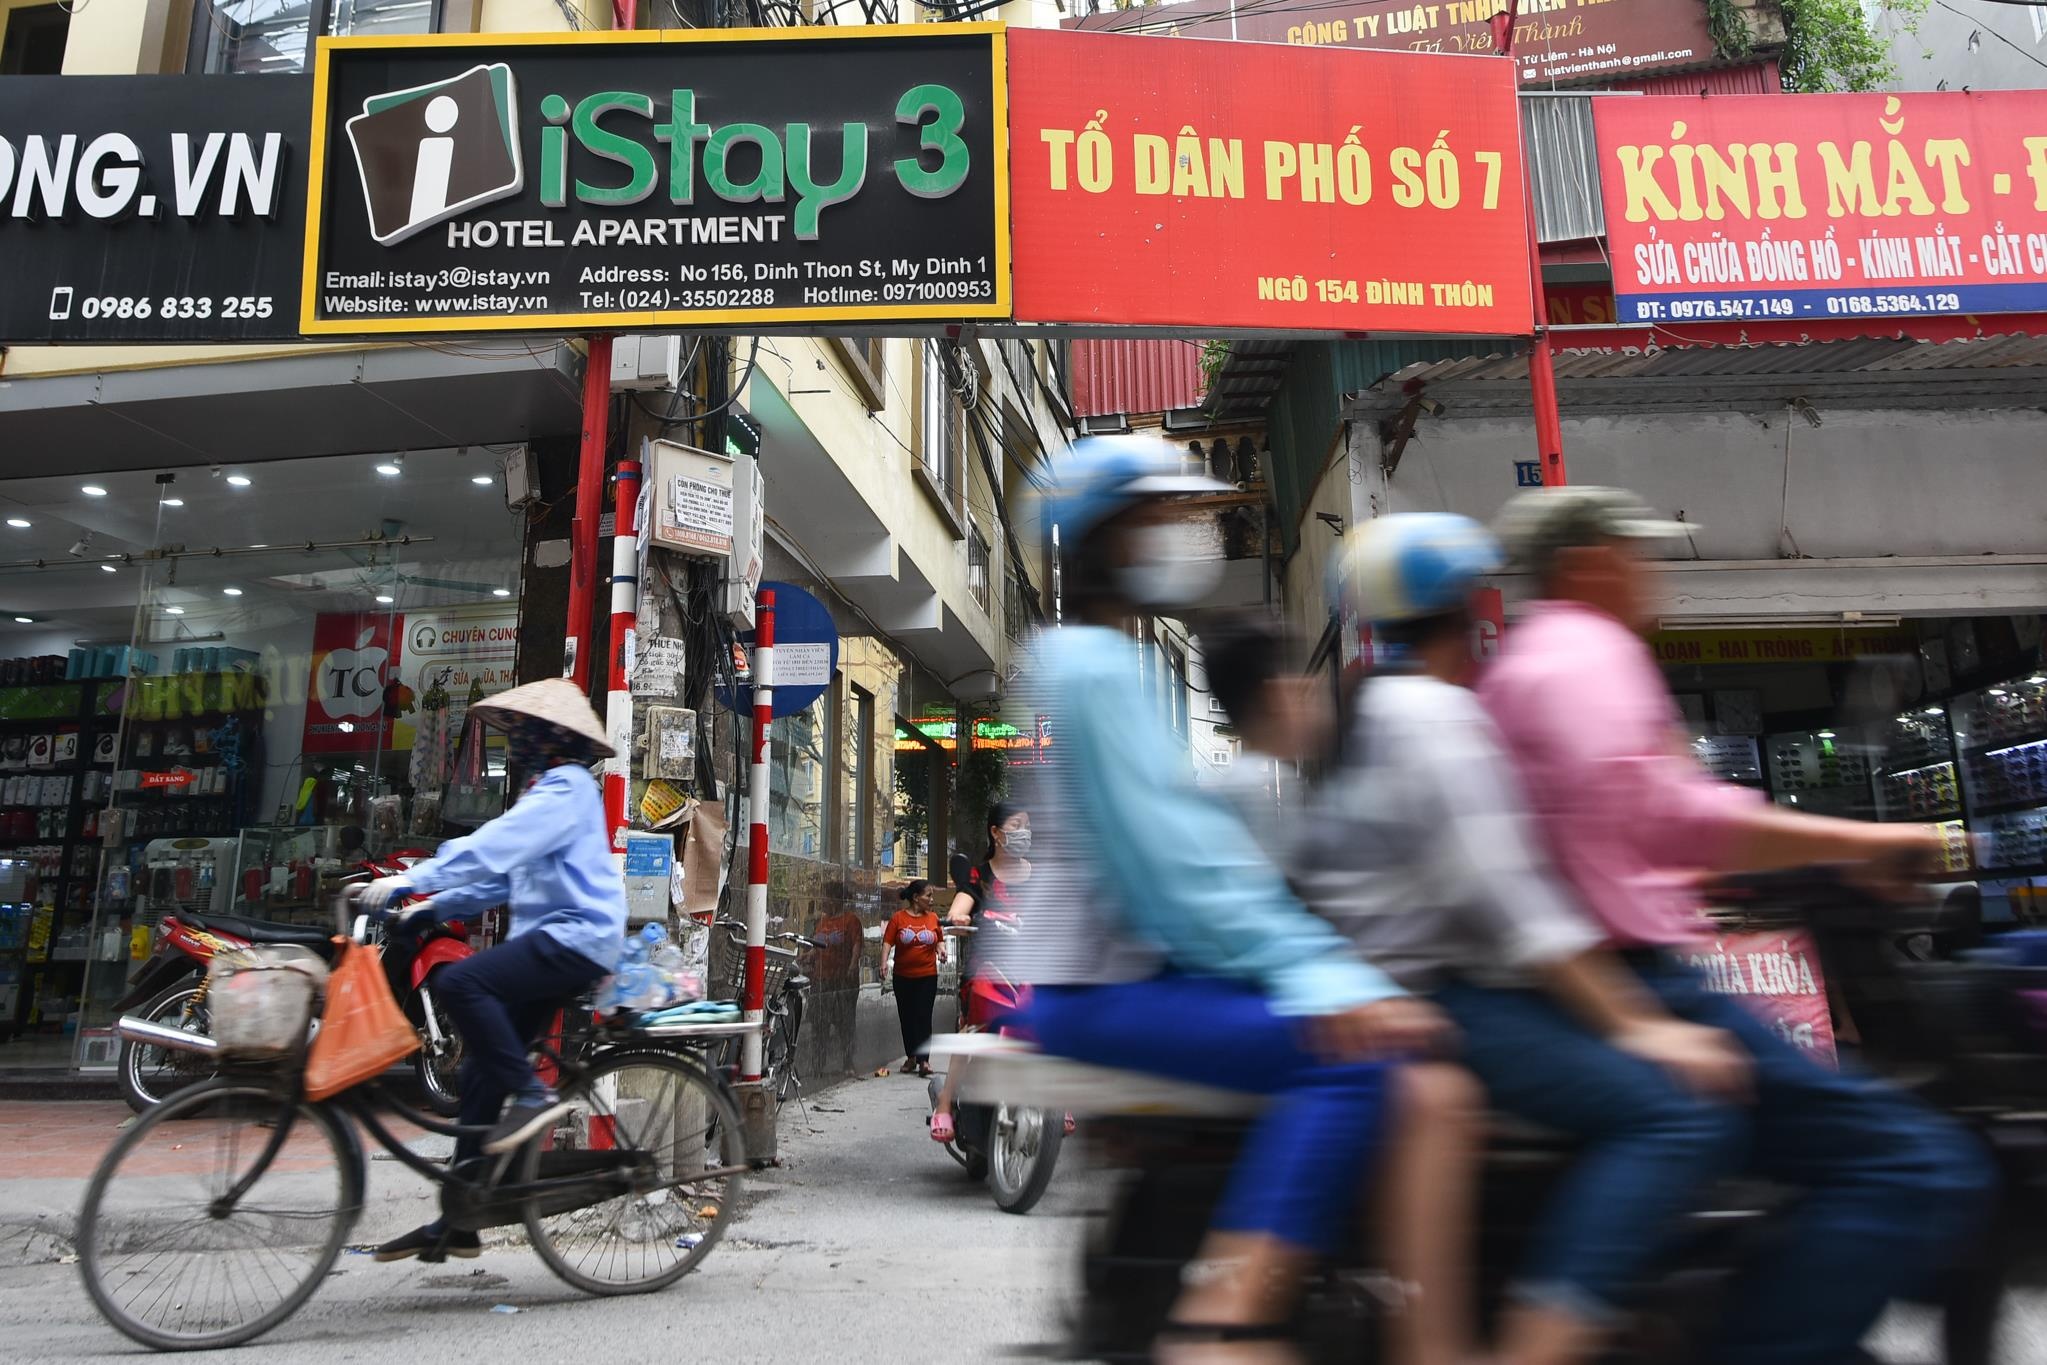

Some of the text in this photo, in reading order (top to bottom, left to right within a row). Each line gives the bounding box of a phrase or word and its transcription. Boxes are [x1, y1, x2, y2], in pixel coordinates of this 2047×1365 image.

[1287, 20, 1348, 45] CÔNG
[1353, 15, 1380, 39] TY
[1387, 5, 1440, 34] LUẬT
[1513, 15, 1585, 44] Thành
[1523, 54, 1538, 64] Từ
[1541, 51, 1568, 63] Liêm
[1579, 47, 1594, 58] Hà
[1597, 44, 1616, 55] Nội
[1544, 48, 1693, 77] luatvienthanh@gmail.com
[540, 84, 971, 241] iStay 3
[1040, 109, 1502, 209] TỔ DÂN PHỐ SỐ 7
[1617, 120, 1807, 222] KÍNH
[1817, 96, 1971, 218] MẮT
[0, 131, 284, 221] NG.VN
[448, 215, 785, 249] HOTEL APARTMENT
[1634, 225, 1681, 286] SỬA
[1684, 231, 1744, 282] CHỮA
[1746, 226, 1808, 281] ĐỒNG
[1810, 224, 1842, 280] HỒ
[1859, 224, 1915, 279] KÍNH
[1918, 222, 1964, 277] MẮT
[1981, 220, 2024, 276] CẮT
[325, 266, 550, 291] Email: istay3@istay.vn
[580, 266, 670, 283] Address:
[754, 263, 798, 280] Dinh
[804, 262, 852, 278] Thon
[859, 260, 886, 279] St,
[892, 260, 919, 280] My
[927, 257, 971, 275] Dinh
[977, 257, 987, 273] 1
[325, 294, 548, 313] Website: www.istay.vn
[804, 285, 878, 304] Hotline:
[883, 280, 992, 300] 0971000953
[1258, 275, 1493, 307] NGÕ 154 ĐÌNH THÔN
[81, 296, 273, 319] 0986 833 255
[1637, 302, 1666, 319] ĐT:
[1670, 298, 1793, 318] 0976.547.149
[1827, 293, 1959, 314] 0168.5364.129
[442, 626, 485, 643] CHUYÊN
[1718, 640, 1749, 659] HAI
[329, 666, 377, 698] TC
[453, 667, 469, 686] SỬA
